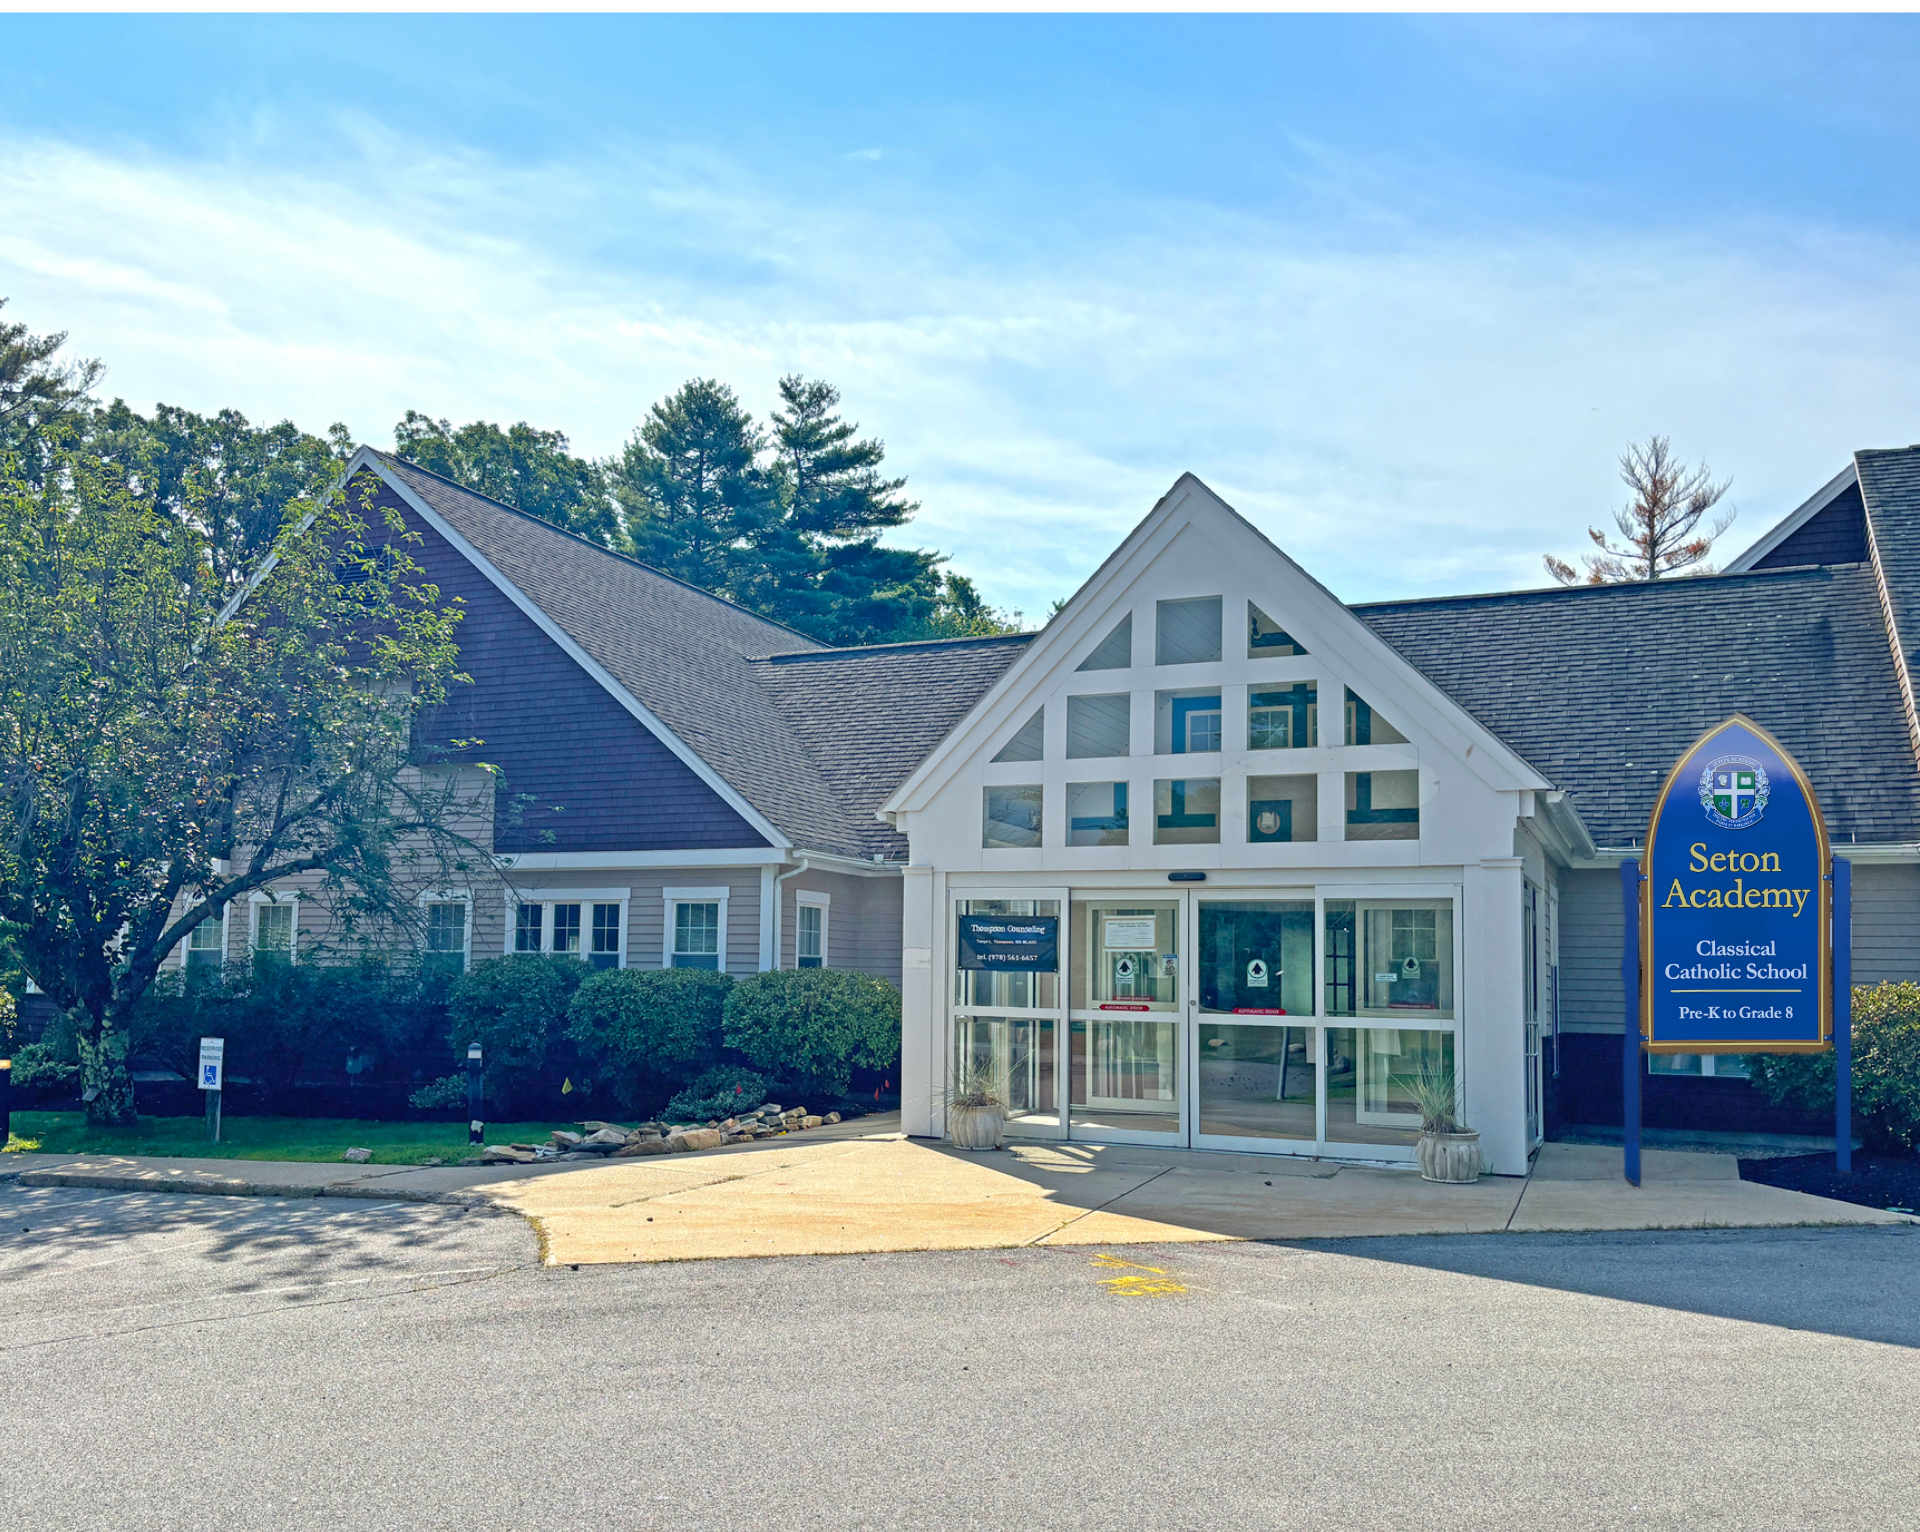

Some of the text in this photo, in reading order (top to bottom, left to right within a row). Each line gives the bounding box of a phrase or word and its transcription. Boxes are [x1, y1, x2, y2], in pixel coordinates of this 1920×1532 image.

[1689, 842, 1782, 873] Seton
[1661, 878, 1812, 918] Academy
[971, 924, 1045, 935] Thompson Counseling
[1696, 940, 1776, 957] Classical
[988, 954, 1006, 962] (978)
[1664, 963, 1808, 980] Catholic School
[1679, 1006, 1794, 1020] Pre-K to Grade 8
